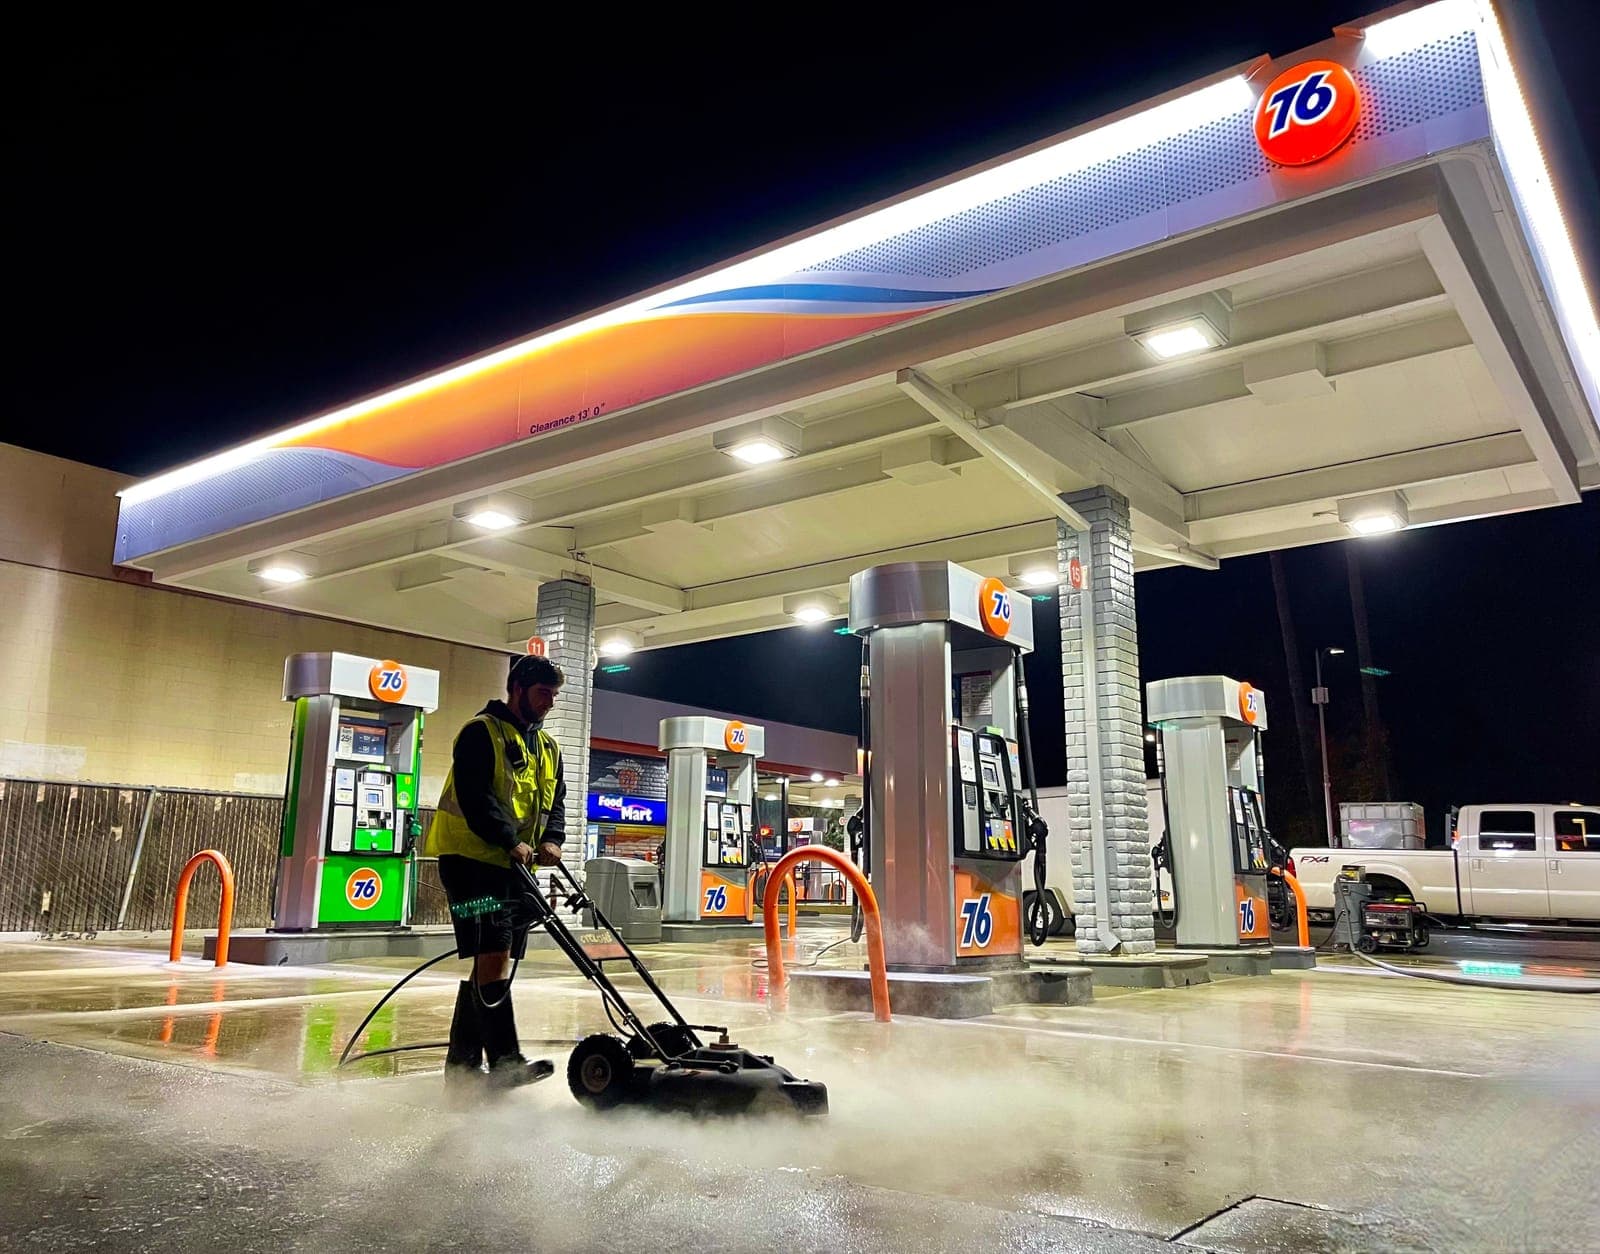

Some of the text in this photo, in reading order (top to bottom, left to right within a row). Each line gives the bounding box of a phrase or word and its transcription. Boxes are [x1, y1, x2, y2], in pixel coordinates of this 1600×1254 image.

[1265, 70, 1336, 140] 76
[530, 414, 575, 434] Clearance
[577, 408, 590, 421] 13'
[1072, 565, 1080, 582] 15
[992, 590, 1010, 621] 76
[531, 642, 542, 656] 11
[380, 671, 402, 691] 76
[732, 729, 745, 743] 76
[598, 795, 623, 808] Food
[621, 806, 653, 822] Mart
[1301, 856, 1330, 864] FX4
[352, 877, 378, 901] 76
[704, 885, 728, 913] 76
[960, 892, 993, 948] 76
[1240, 897, 1255, 933] 76
